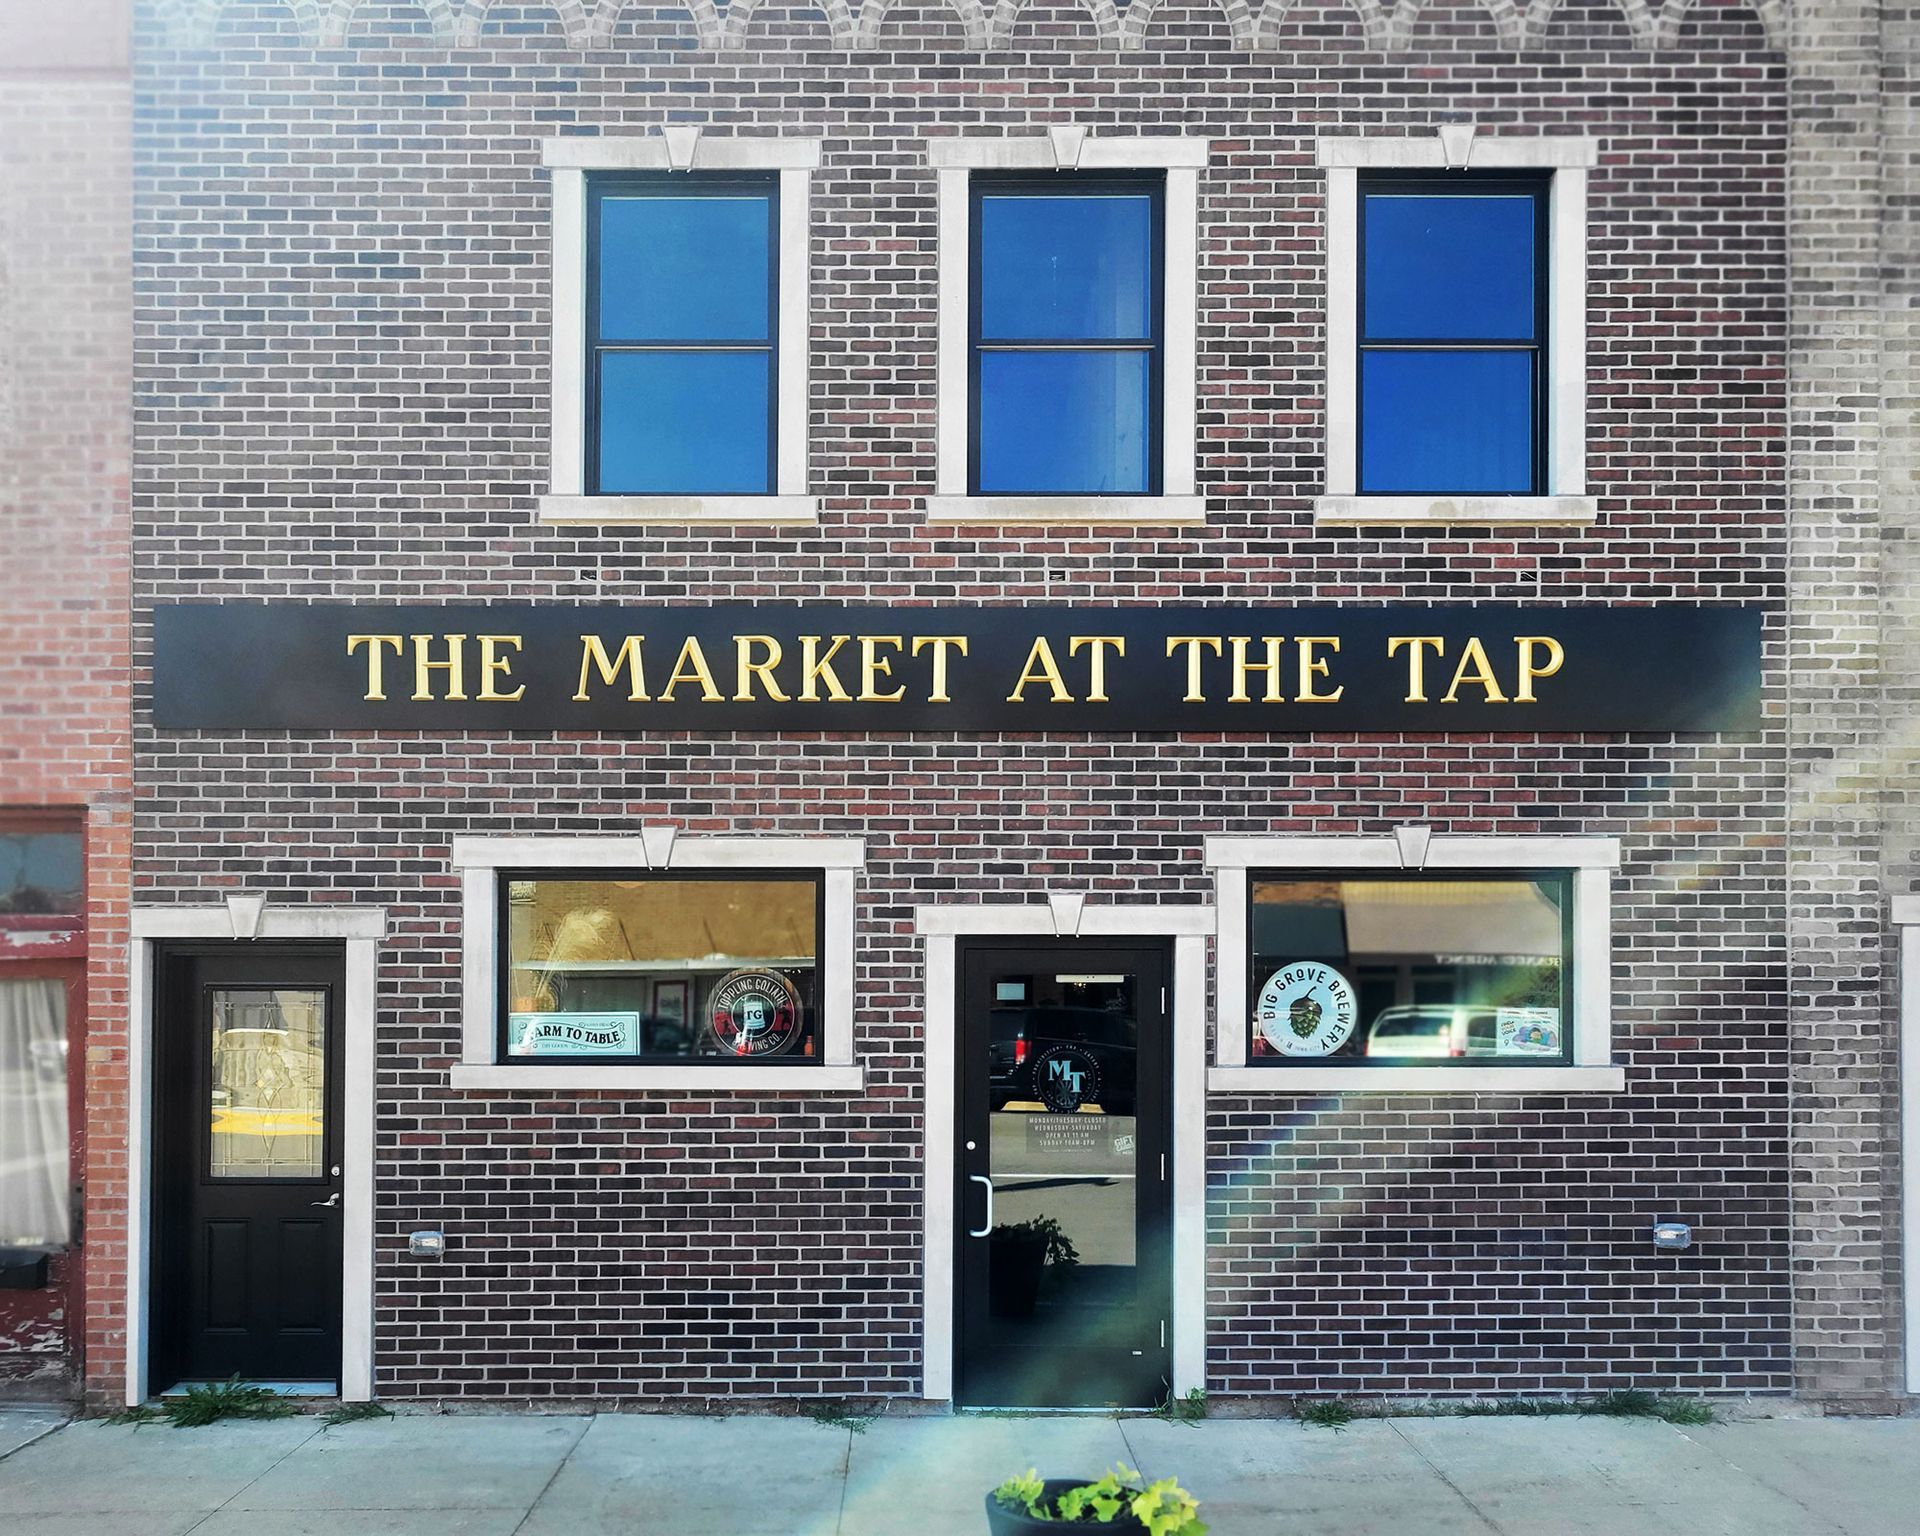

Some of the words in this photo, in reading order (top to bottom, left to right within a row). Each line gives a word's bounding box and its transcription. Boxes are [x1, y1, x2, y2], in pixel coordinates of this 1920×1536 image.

[347, 634, 526, 701] THE
[572, 634, 968, 702] MARKET
[1006, 636, 1125, 702] AT
[1166, 636, 1344, 702] THE
[1388, 636, 1564, 702] TAP
[717, 979, 753, 1009] TOPPLING
[755, 978, 788, 1008] GOLIATH
[1263, 994, 1278, 1019] BIG
[1275, 968, 1326, 991] GROVE
[1321, 980, 1350, 1050] BREWERY
[535, 1025, 562, 1037] ARM
[566, 1027, 582, 1040] TO
[585, 1030, 621, 1044] TABLE
[1114, 1135, 1133, 1146] GIFT
